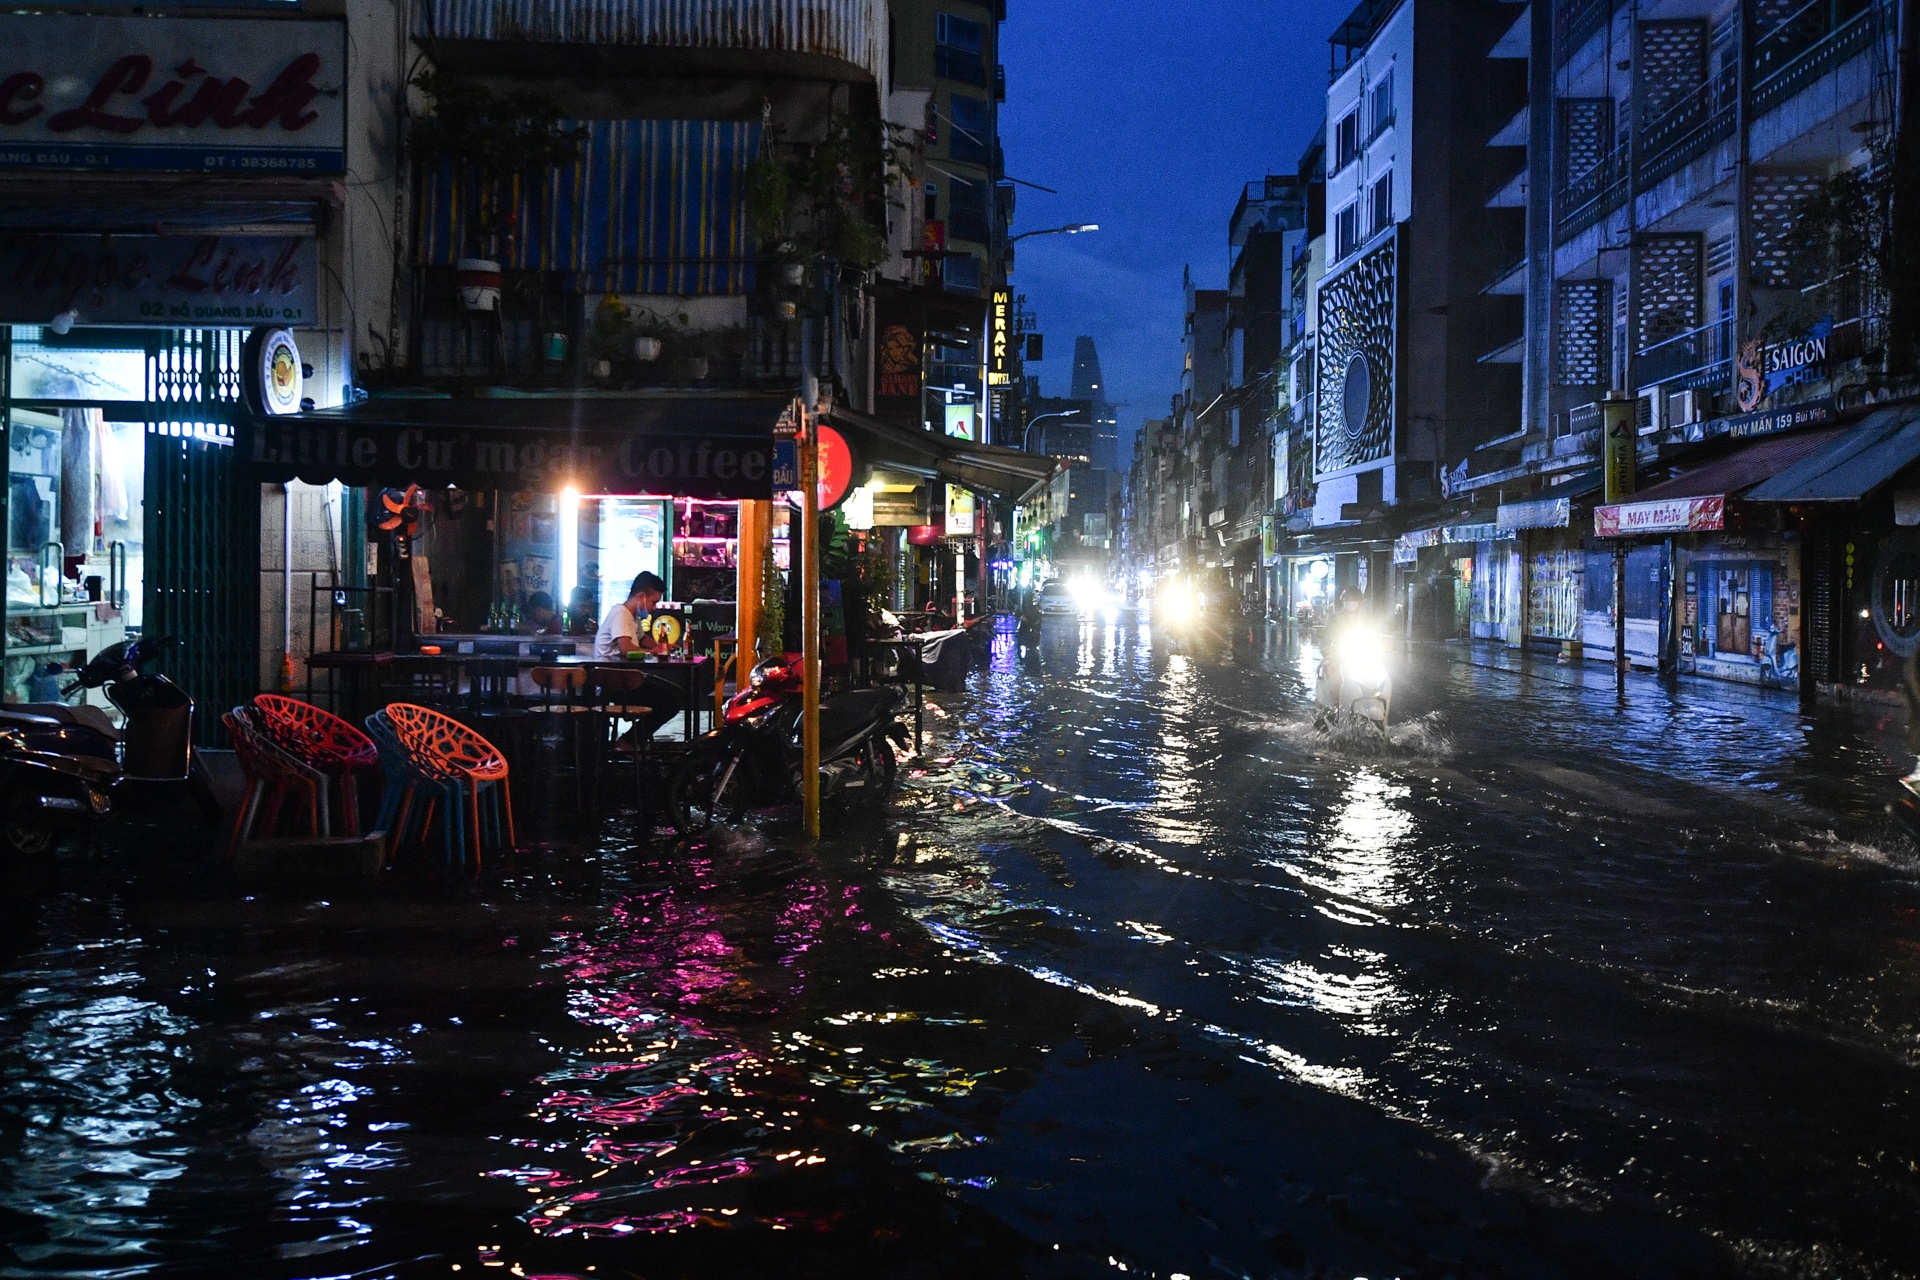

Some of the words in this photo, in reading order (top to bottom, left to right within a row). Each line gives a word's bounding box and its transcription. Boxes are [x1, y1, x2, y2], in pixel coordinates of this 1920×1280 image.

[48, 53, 320, 133] Linh
[162, 236, 303, 295] Linh
[140, 302, 164, 317] 02
[195, 307, 245, 318] QUANG
[993, 291, 1008, 370] MERAKI
[1772, 337, 1826, 371] SAIGON
[1730, 422, 1749, 437] MAY
[1776, 413, 1793, 429] 159
[252, 421, 378, 469] Little
[619, 436, 767, 480] Coffee
[1627, 510, 1651, 525] MAY
[706, 620, 734, 635] Worry
[1682, 628, 1692, 639] ALL
